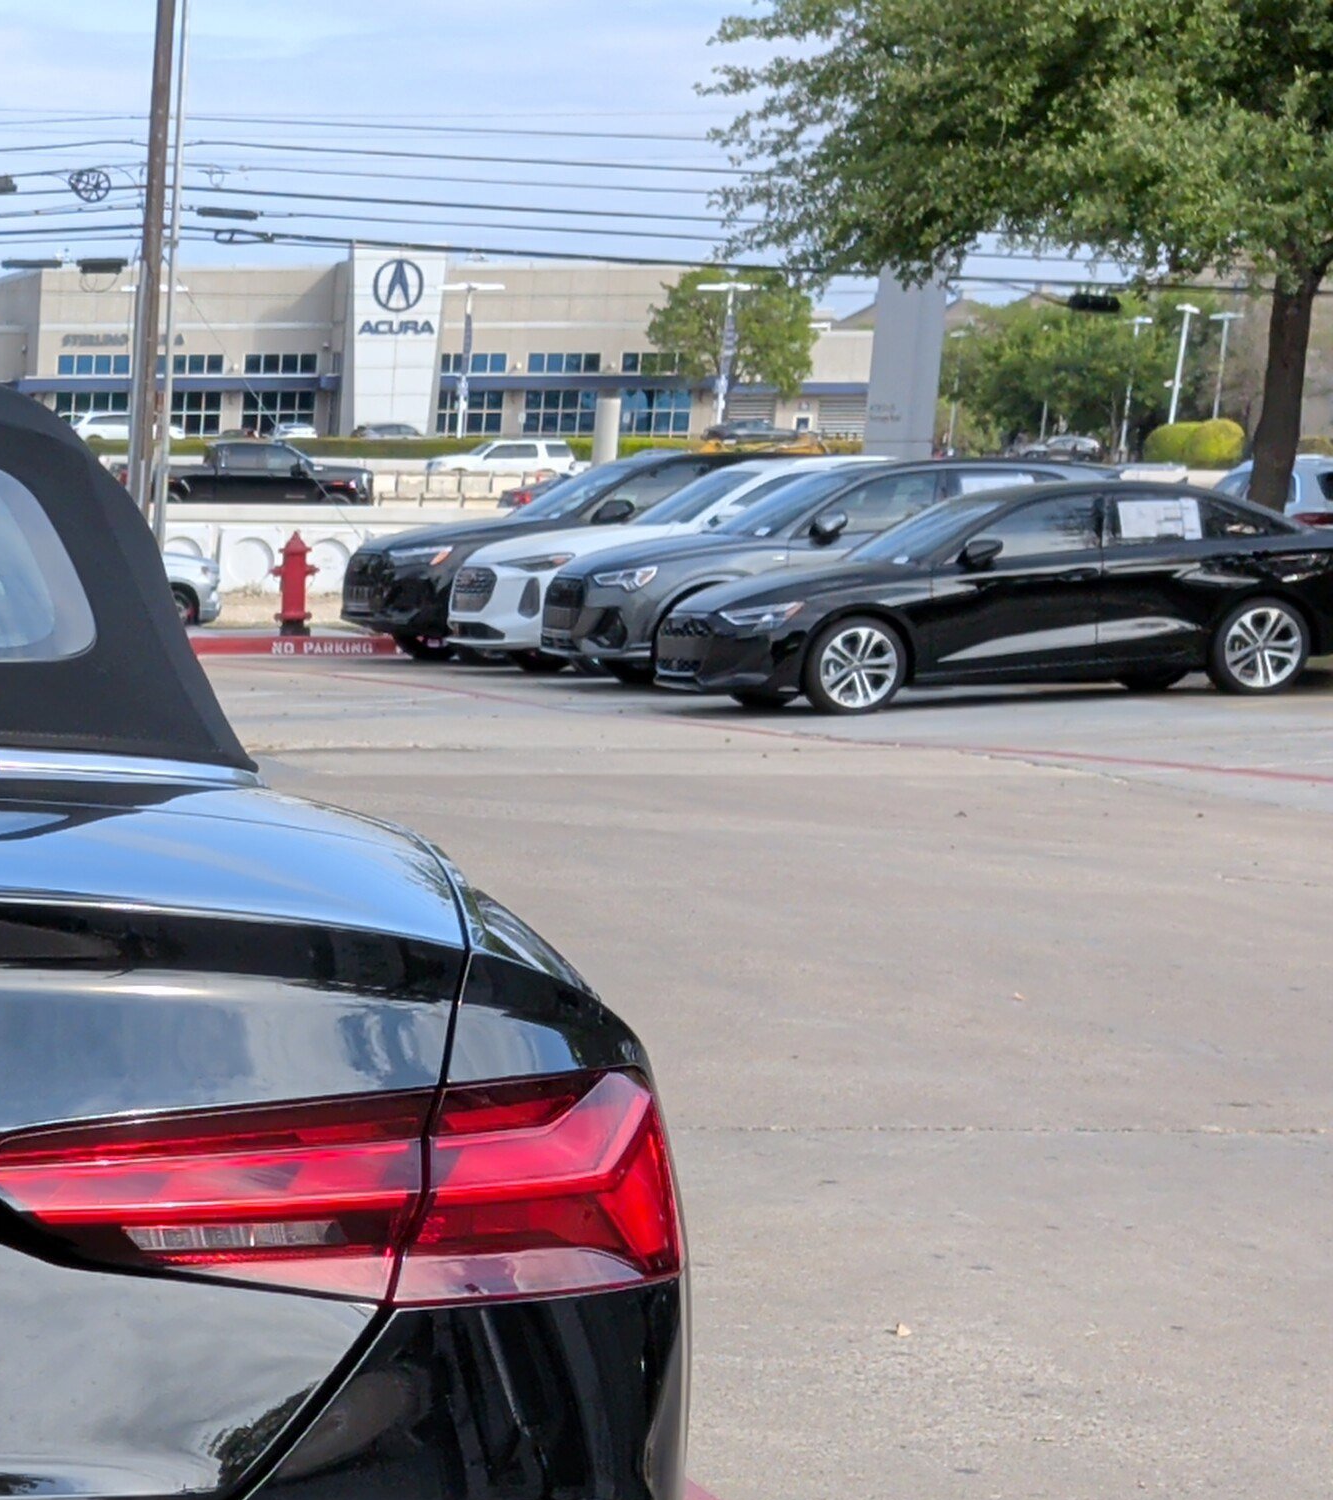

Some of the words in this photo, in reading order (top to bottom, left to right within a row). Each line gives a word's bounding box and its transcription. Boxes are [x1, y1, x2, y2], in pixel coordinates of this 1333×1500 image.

[358, 320, 434, 335] ACURA
[271, 642, 295, 655] NO
[303, 641, 373, 655] PARKING
